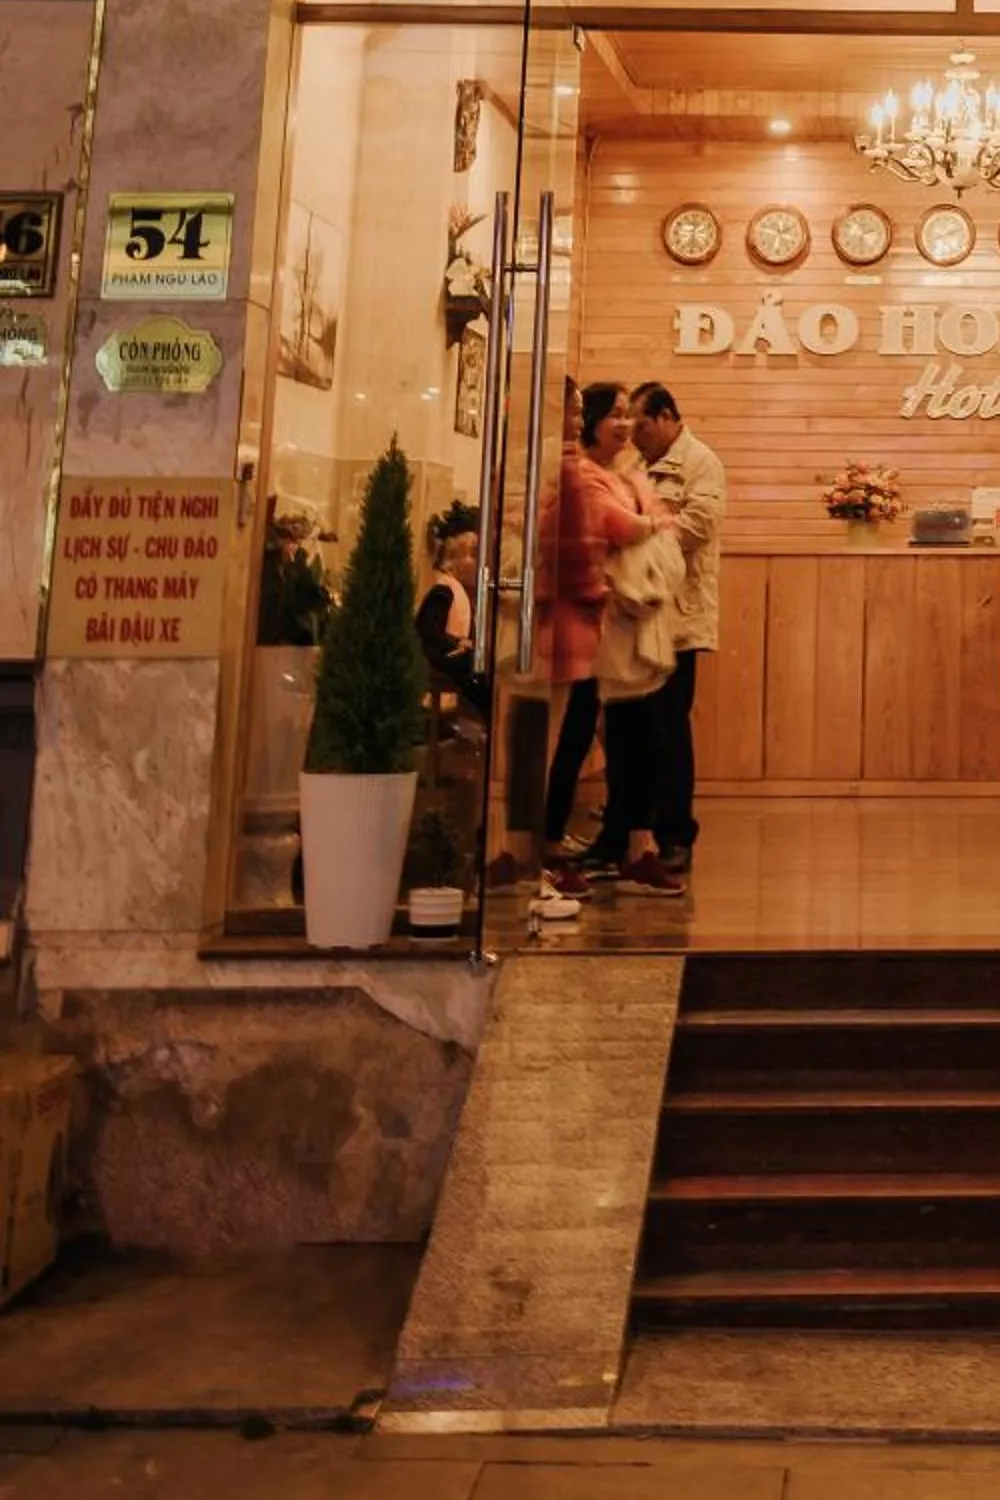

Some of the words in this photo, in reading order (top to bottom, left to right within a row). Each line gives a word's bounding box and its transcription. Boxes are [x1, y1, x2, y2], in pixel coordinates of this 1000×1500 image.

[0, 210, 44, 255] 6
[125, 208, 210, 261] 54
[673, 289, 859, 357] ĐẢO
[180, 495, 219, 519] NGHI
[145, 535, 179, 560] CHU
[103, 576, 158, 600] THANG
[160, 616, 182, 643] XE
